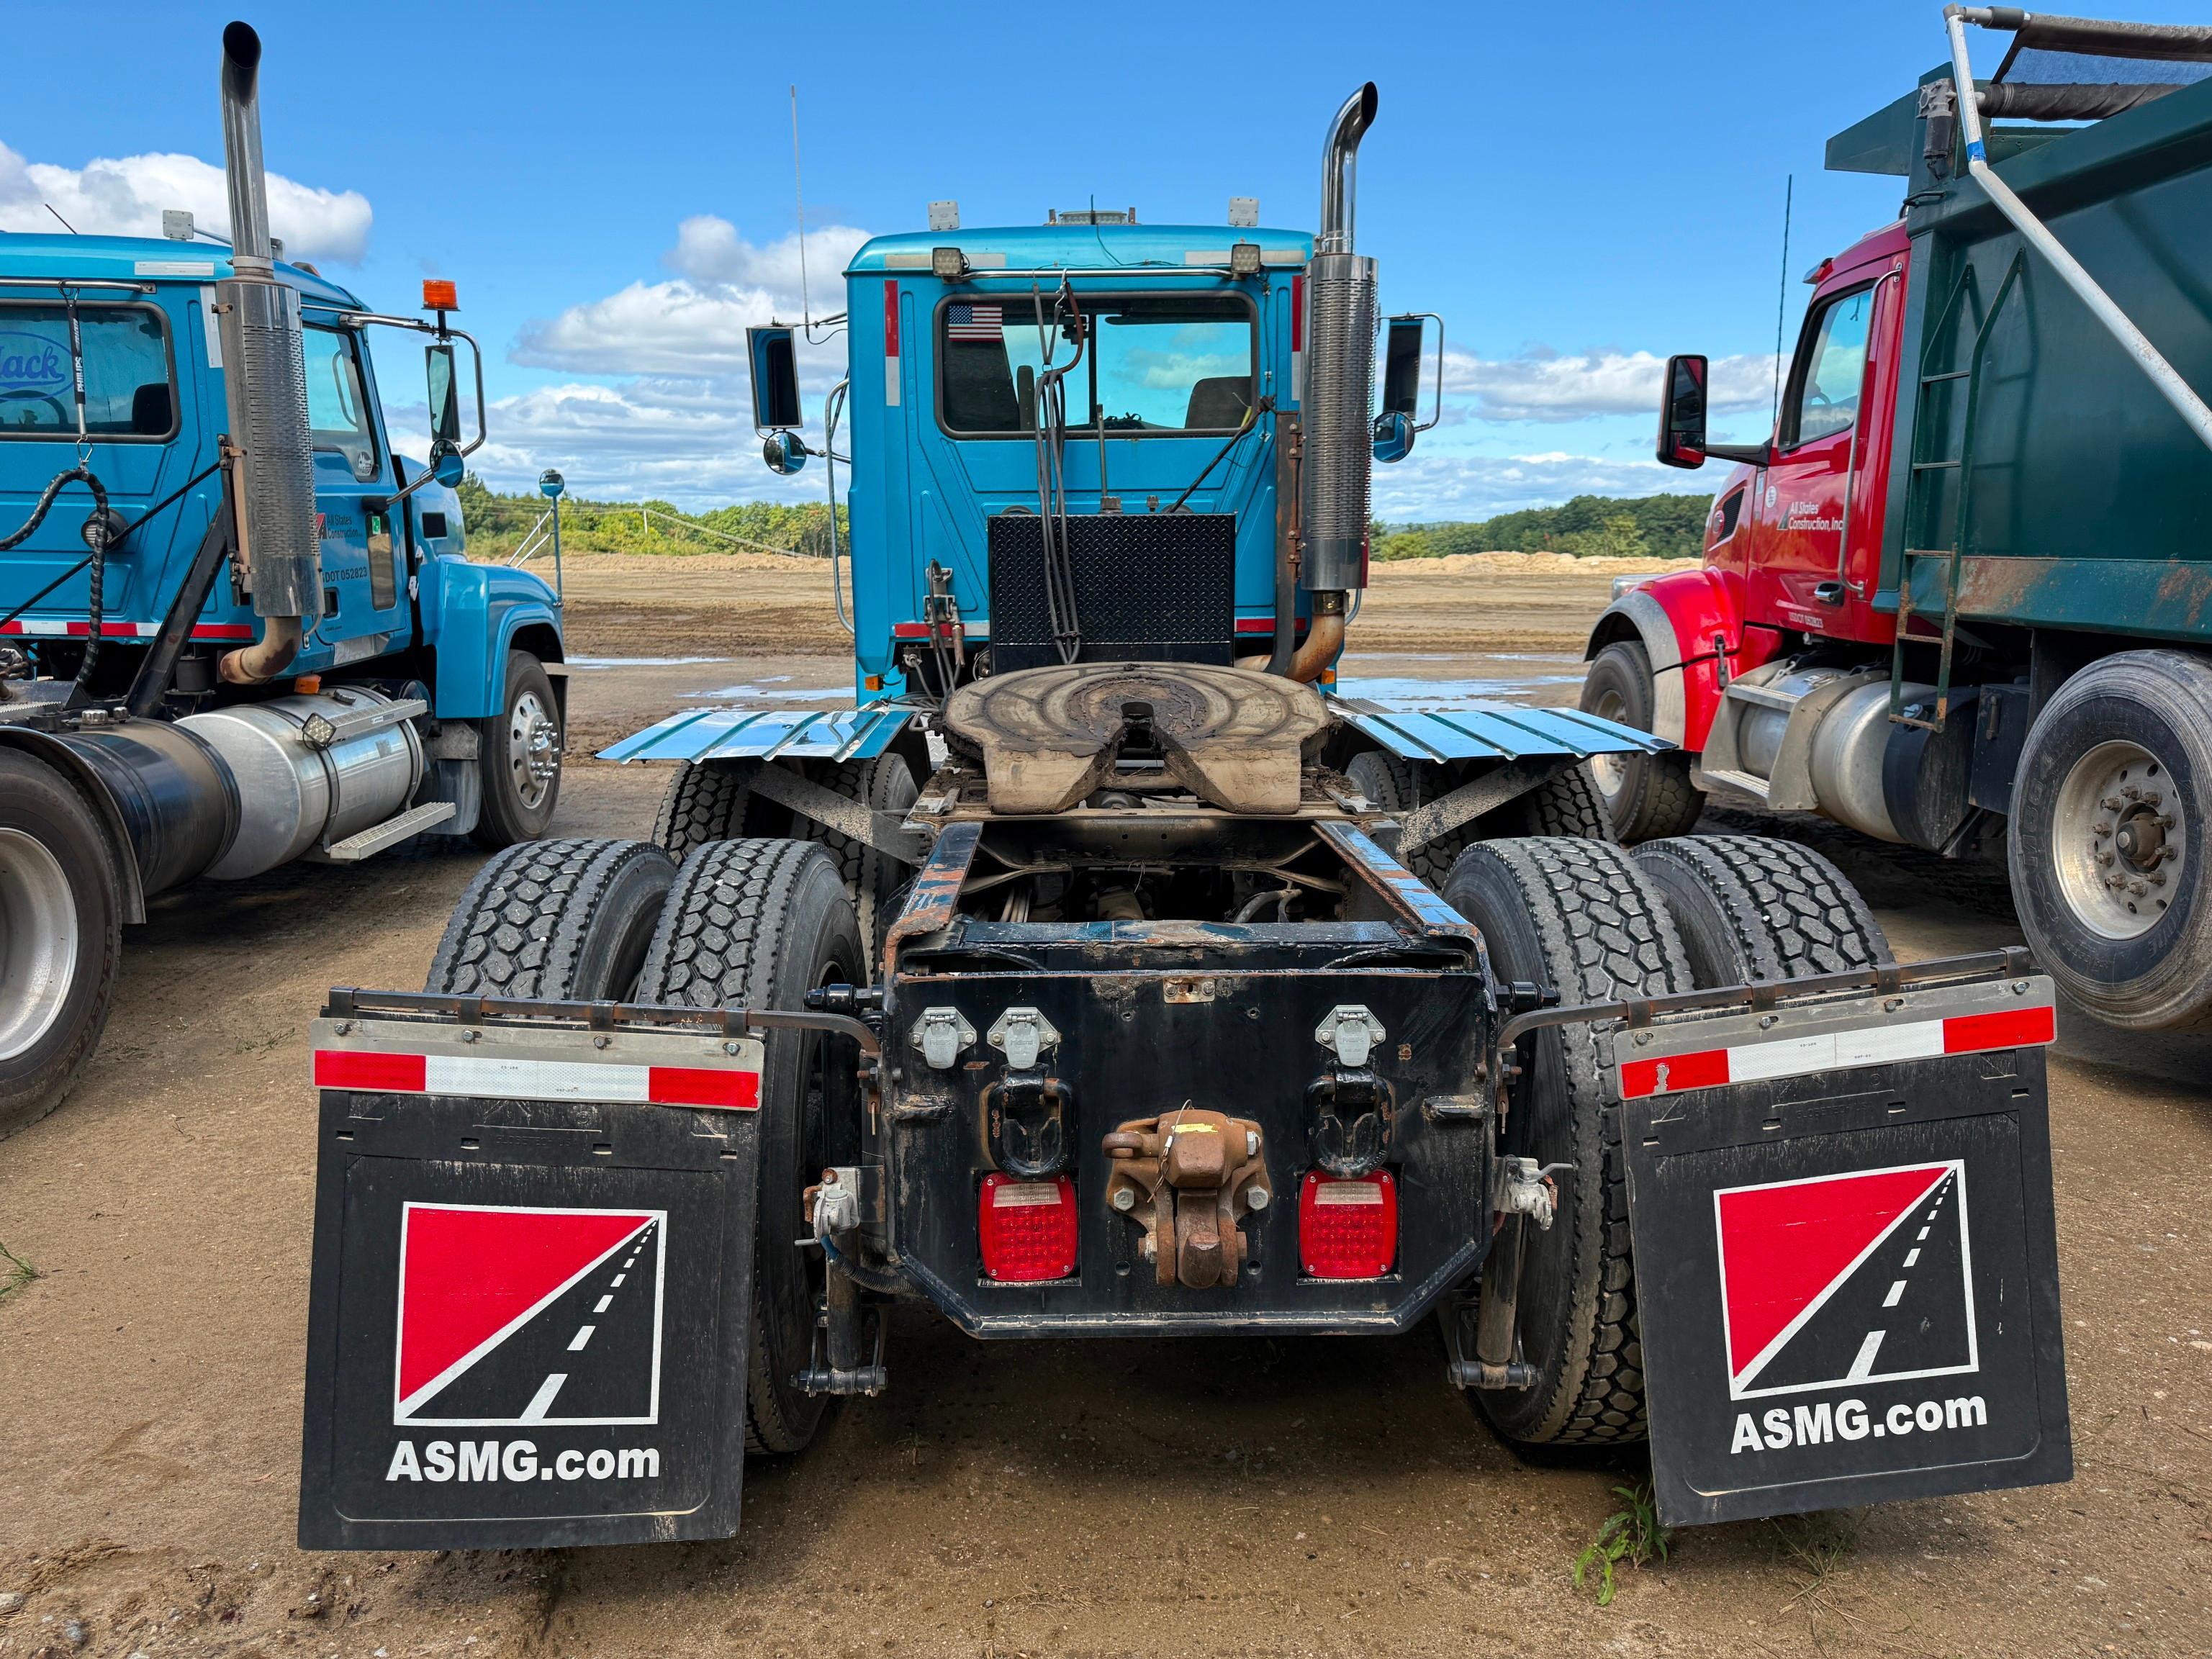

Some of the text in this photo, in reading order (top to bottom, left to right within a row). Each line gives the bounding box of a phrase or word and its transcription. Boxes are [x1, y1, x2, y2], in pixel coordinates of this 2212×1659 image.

[1799, 502, 1819, 515] States
[335, 514, 352, 525] States
[340, 566, 368, 581] 052823
[1730, 1396, 1987, 1454] ASMG.com
[386, 1440, 660, 1482] ASMG.com
